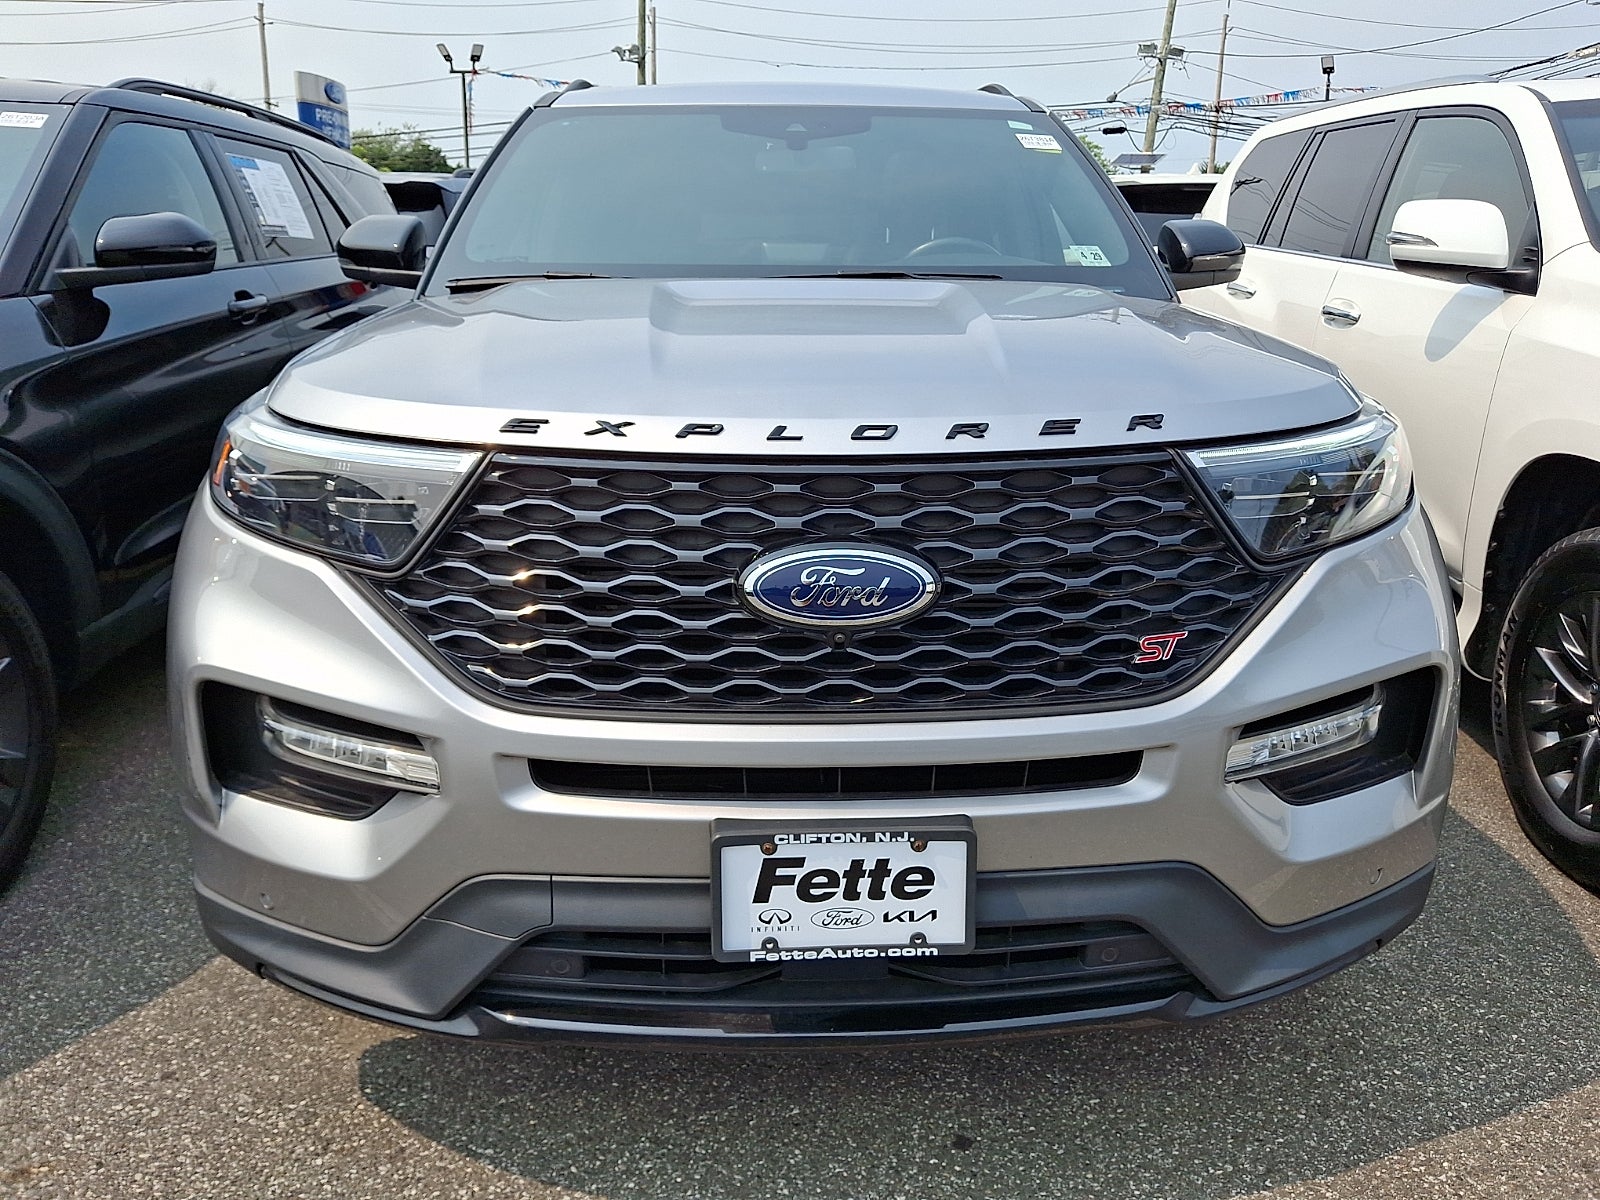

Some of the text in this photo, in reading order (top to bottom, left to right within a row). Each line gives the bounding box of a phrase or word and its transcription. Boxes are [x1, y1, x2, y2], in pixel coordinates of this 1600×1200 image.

[1090, 252, 1103, 261] 29
[499, 413, 1165, 442] EXPLORER
[790, 565, 891, 607] Ford
[1134, 631, 1188, 664] ST
[1493, 609, 1519, 737] IRONMAN
[774, 832, 915, 845] CLIFTON, N.J.
[751, 856, 936, 904] Fette
[820, 908, 864, 927] Ford
[882, 909, 938, 923] KIA
[750, 925, 800, 933] INFINITI
[750, 947, 938, 962] FetteAuto.com
